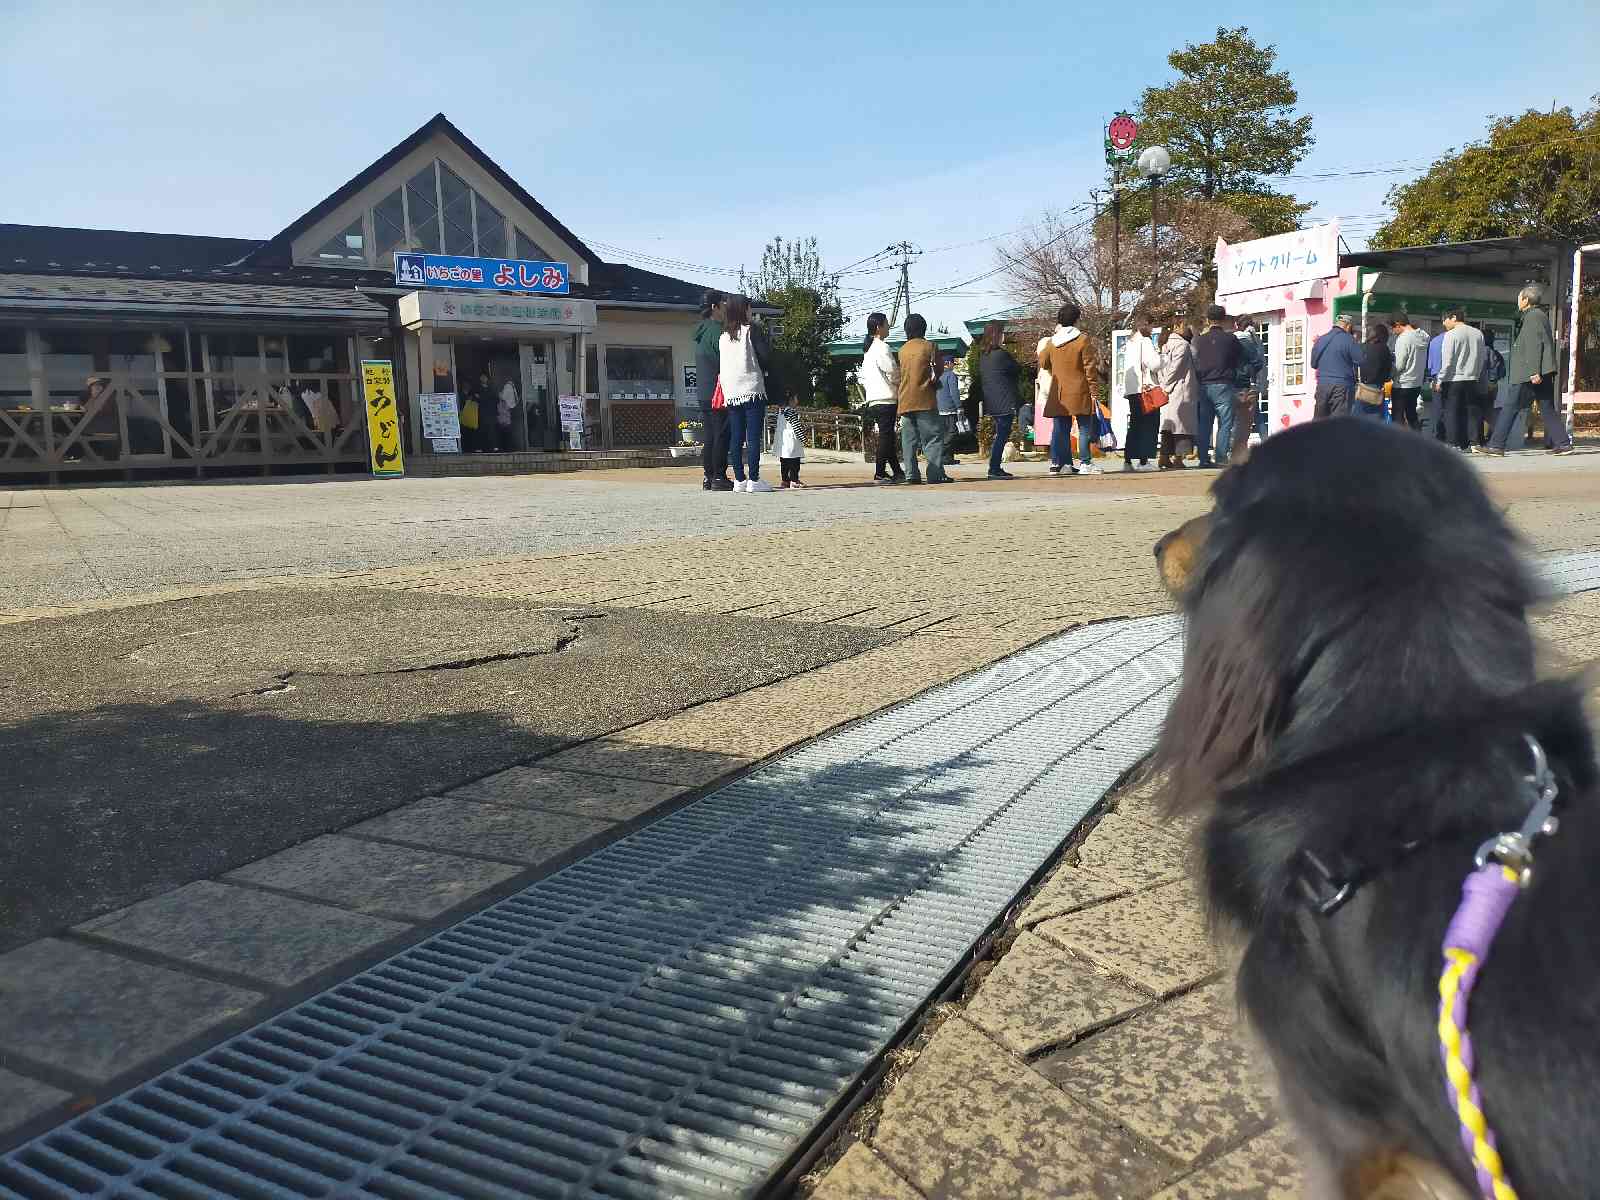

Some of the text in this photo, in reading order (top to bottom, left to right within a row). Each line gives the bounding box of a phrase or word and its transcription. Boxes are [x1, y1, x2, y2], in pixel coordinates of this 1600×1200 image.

[426, 264, 565, 289] いちごの里 よしみ
[1234, 249, 1318, 277] ソフトクリーム
[370, 387, 399, 469] うどん
